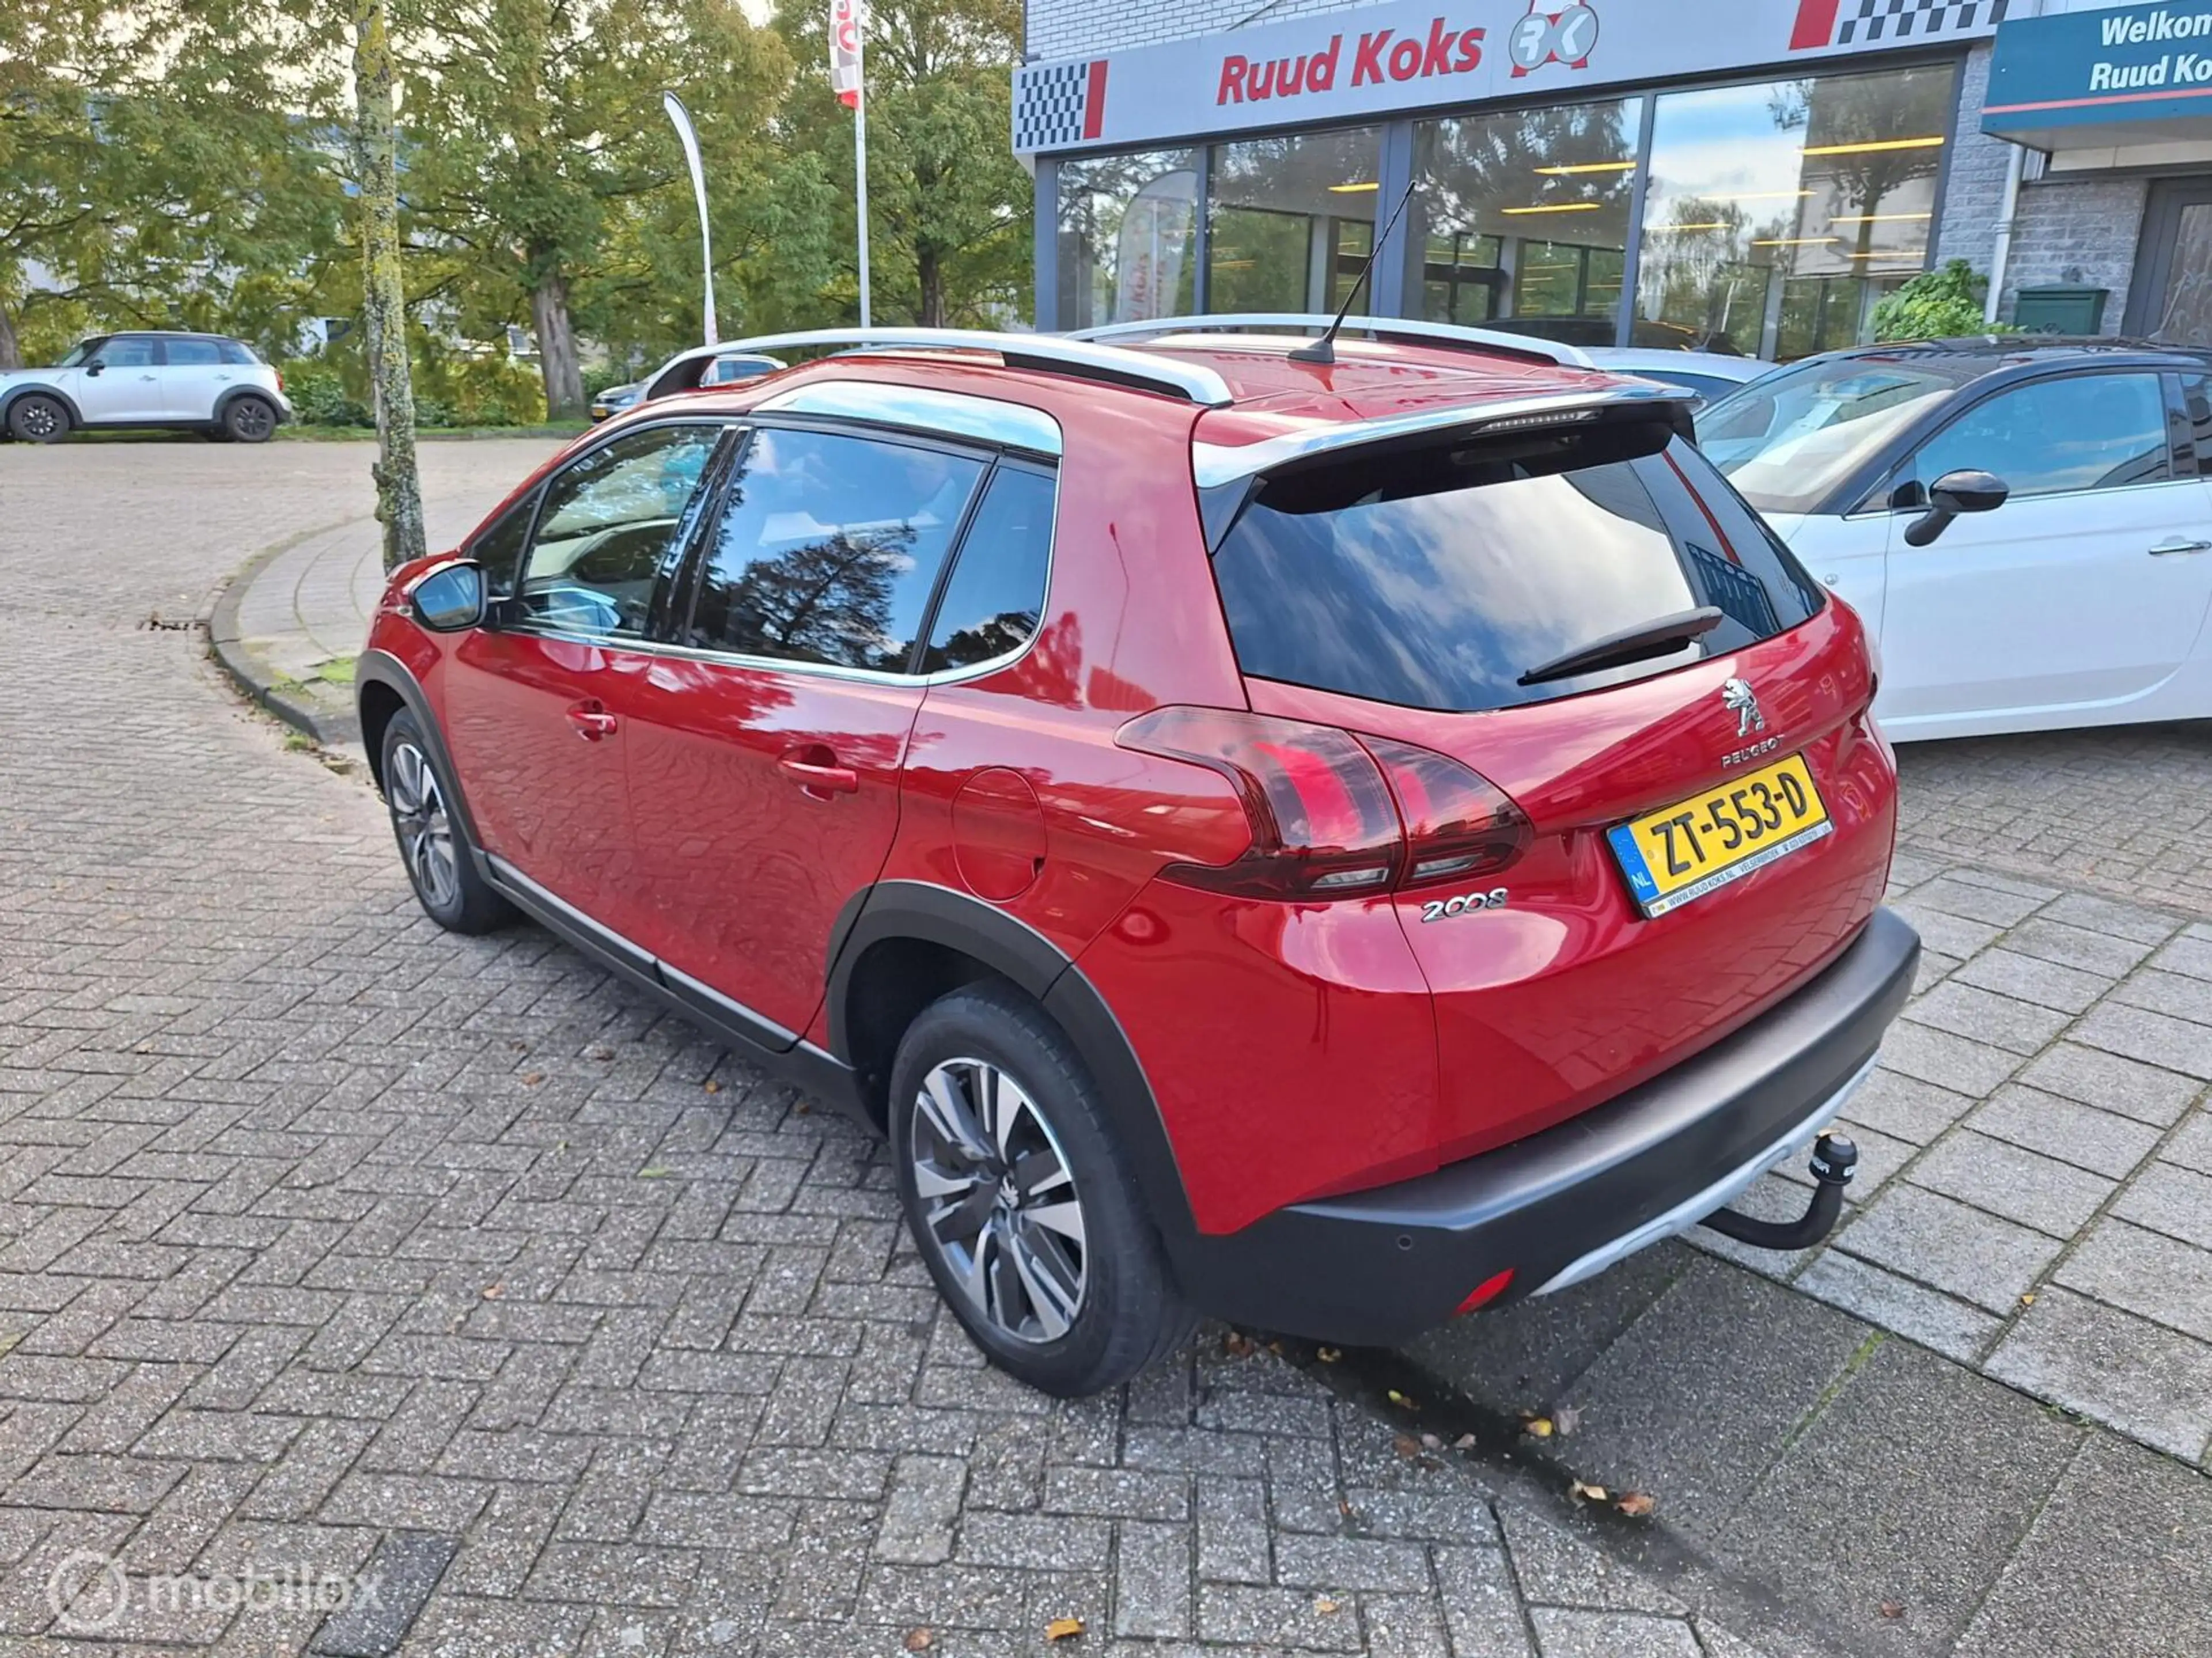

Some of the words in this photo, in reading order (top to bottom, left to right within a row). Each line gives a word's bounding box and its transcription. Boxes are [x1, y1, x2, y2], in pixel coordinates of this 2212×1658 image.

[1217, 33, 1343, 105] Ruud
[1350, 17, 1486, 88] Koks
[2089, 55, 2170, 91] Ruud
[1721, 734, 1785, 769] PEUGEOT
[1651, 772, 1807, 877] ZT-553-D
[1631, 873, 1652, 890] NL
[1421, 887, 1509, 923] 2008
